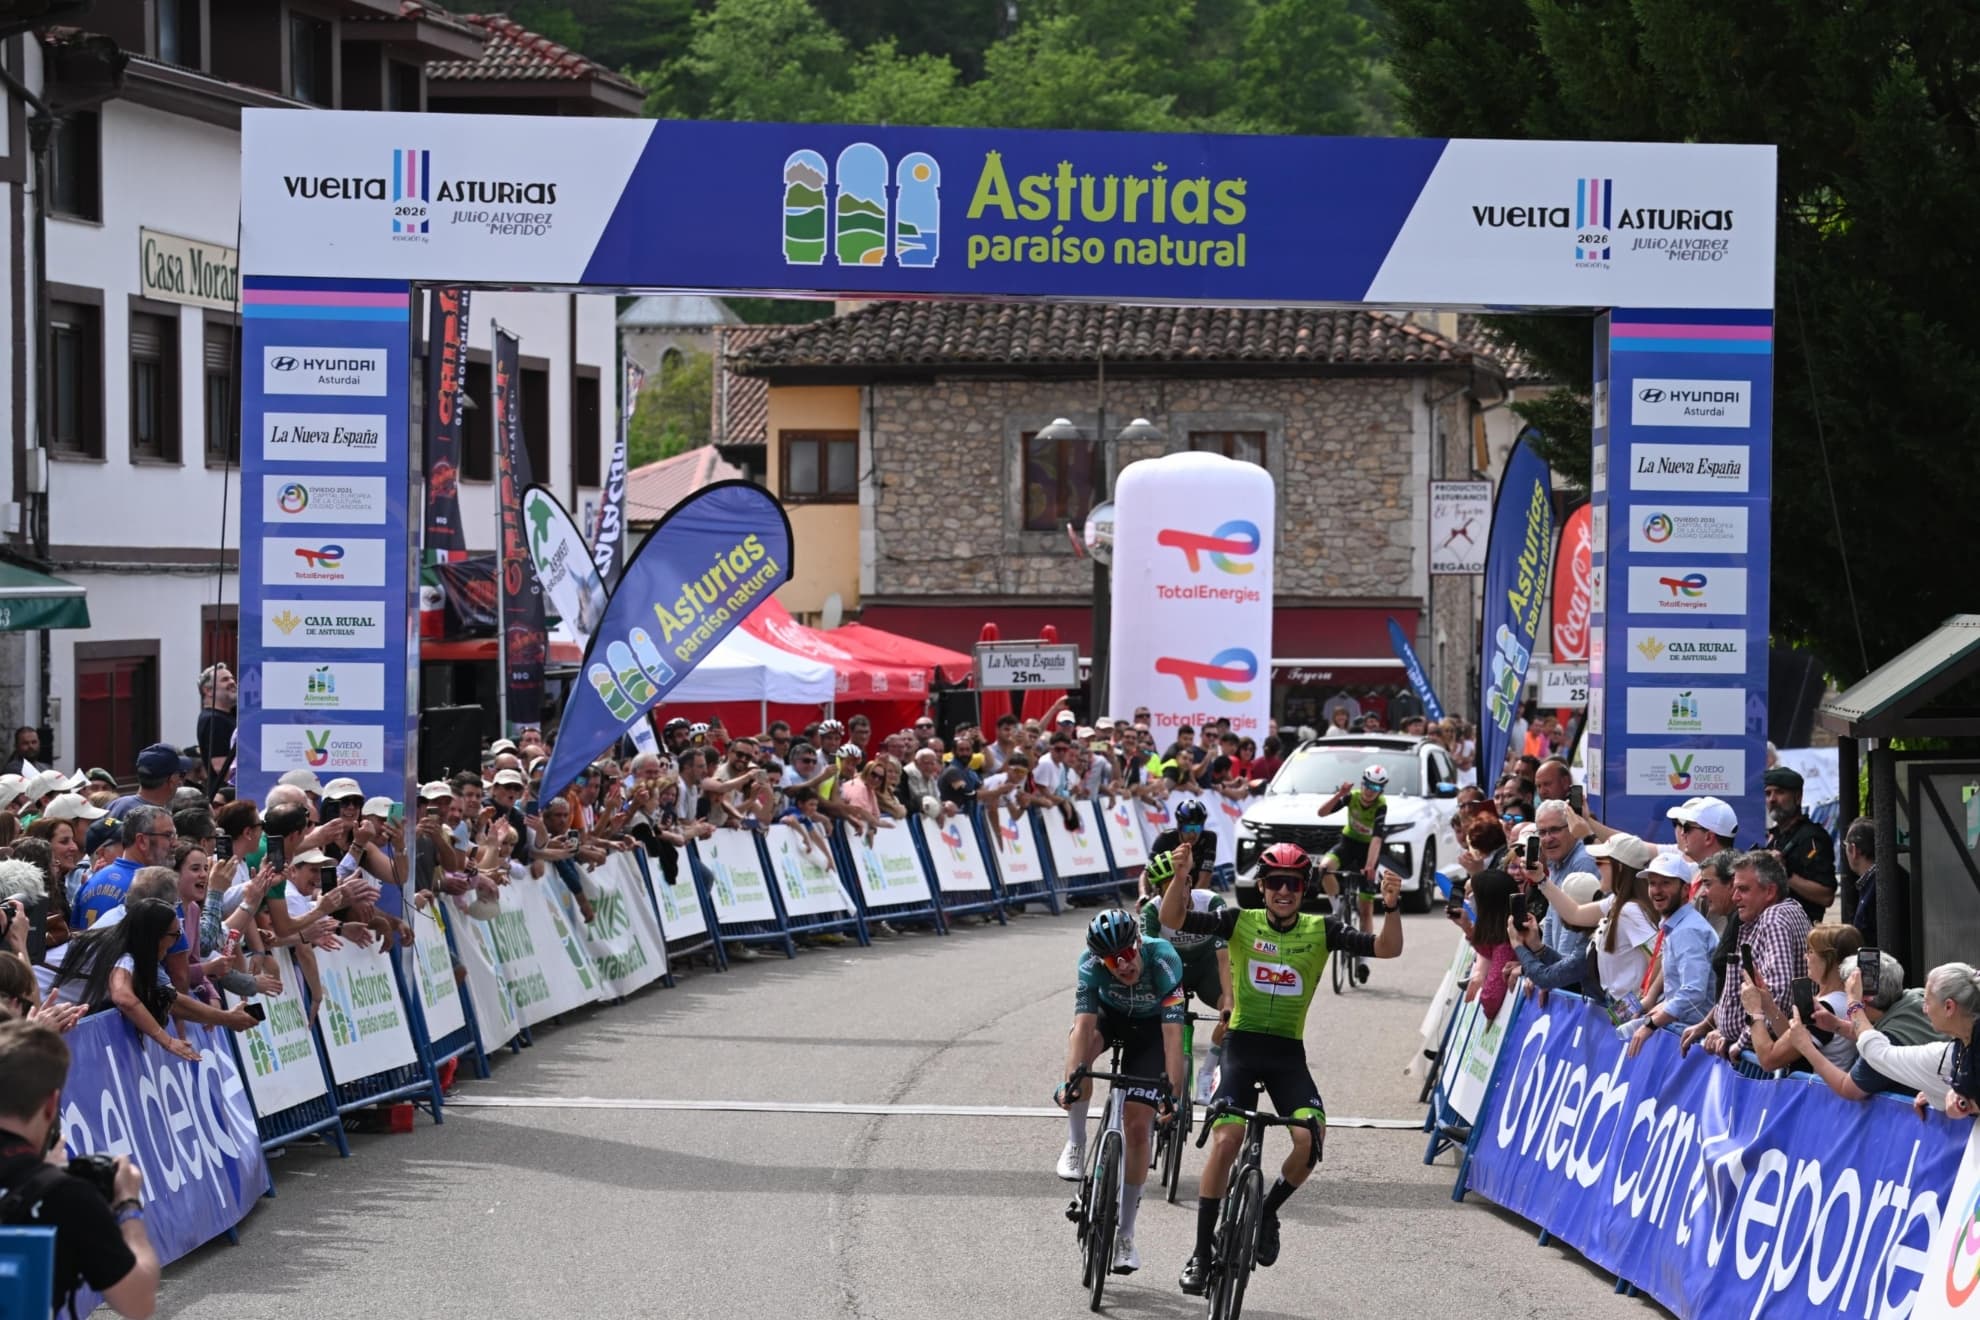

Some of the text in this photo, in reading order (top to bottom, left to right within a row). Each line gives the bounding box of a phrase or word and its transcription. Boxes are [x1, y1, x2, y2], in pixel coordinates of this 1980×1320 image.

[966, 149, 1247, 225] Asturias
[394, 206, 427, 217] 2026
[1577, 234, 1609, 244] 2026
[966, 225, 1246, 270] paraíso natural
[144, 238, 185, 294] Casa
[303, 358, 376, 372] HYUNDAI
[318, 375, 360, 385] Asturdai
[1670, 390, 1739, 403] HYUNDAI
[1683, 407, 1725, 417] Asturdai
[270, 426, 379, 447] La Nueva España
[1637, 456, 1742, 477] La Nueva España
[1434, 484, 1488, 492] PRODUCTOS
[1434, 493, 1488, 501] ASTURIANOS
[1507, 478, 1545, 626] Asturias
[295, 571, 345, 581] TotalEnergies
[653, 533, 766, 645] Asturias
[1157, 584, 1261, 605] TotalEnergies
[1524, 563, 1549, 640] paraíso
[1658, 600, 1708, 609] TotalEnergies
[674, 606, 732, 663] paraíso
[725, 557, 782, 613] natural
[304, 616, 376, 627] CAJA RURAL
[318, 628, 356, 636] ASTURIAS
[1668, 642, 1738, 653] CAJA RURAL
[987, 653, 1066, 669] La Nueva España
[1681, 654, 1717, 662] ASTURIAS
[1012, 671, 1046, 683] 25m.
[1547, 671, 1560, 687] La
[1570, 688, 1589, 701] 25
[1154, 712, 1257, 731] TotalEngies
[330, 741, 362, 749] OVIEDO
[330, 758, 369, 767] DEPORTE
[1694, 765, 1725, 774] OVIEDO
[1694, 782, 1729, 791] DEPORTE
[1255, 966, 1297, 984] Dole
[346, 965, 393, 1010] Asturias
[1498, 1013, 1631, 1189] Oviedo
[1613, 1096, 1697, 1231] con
